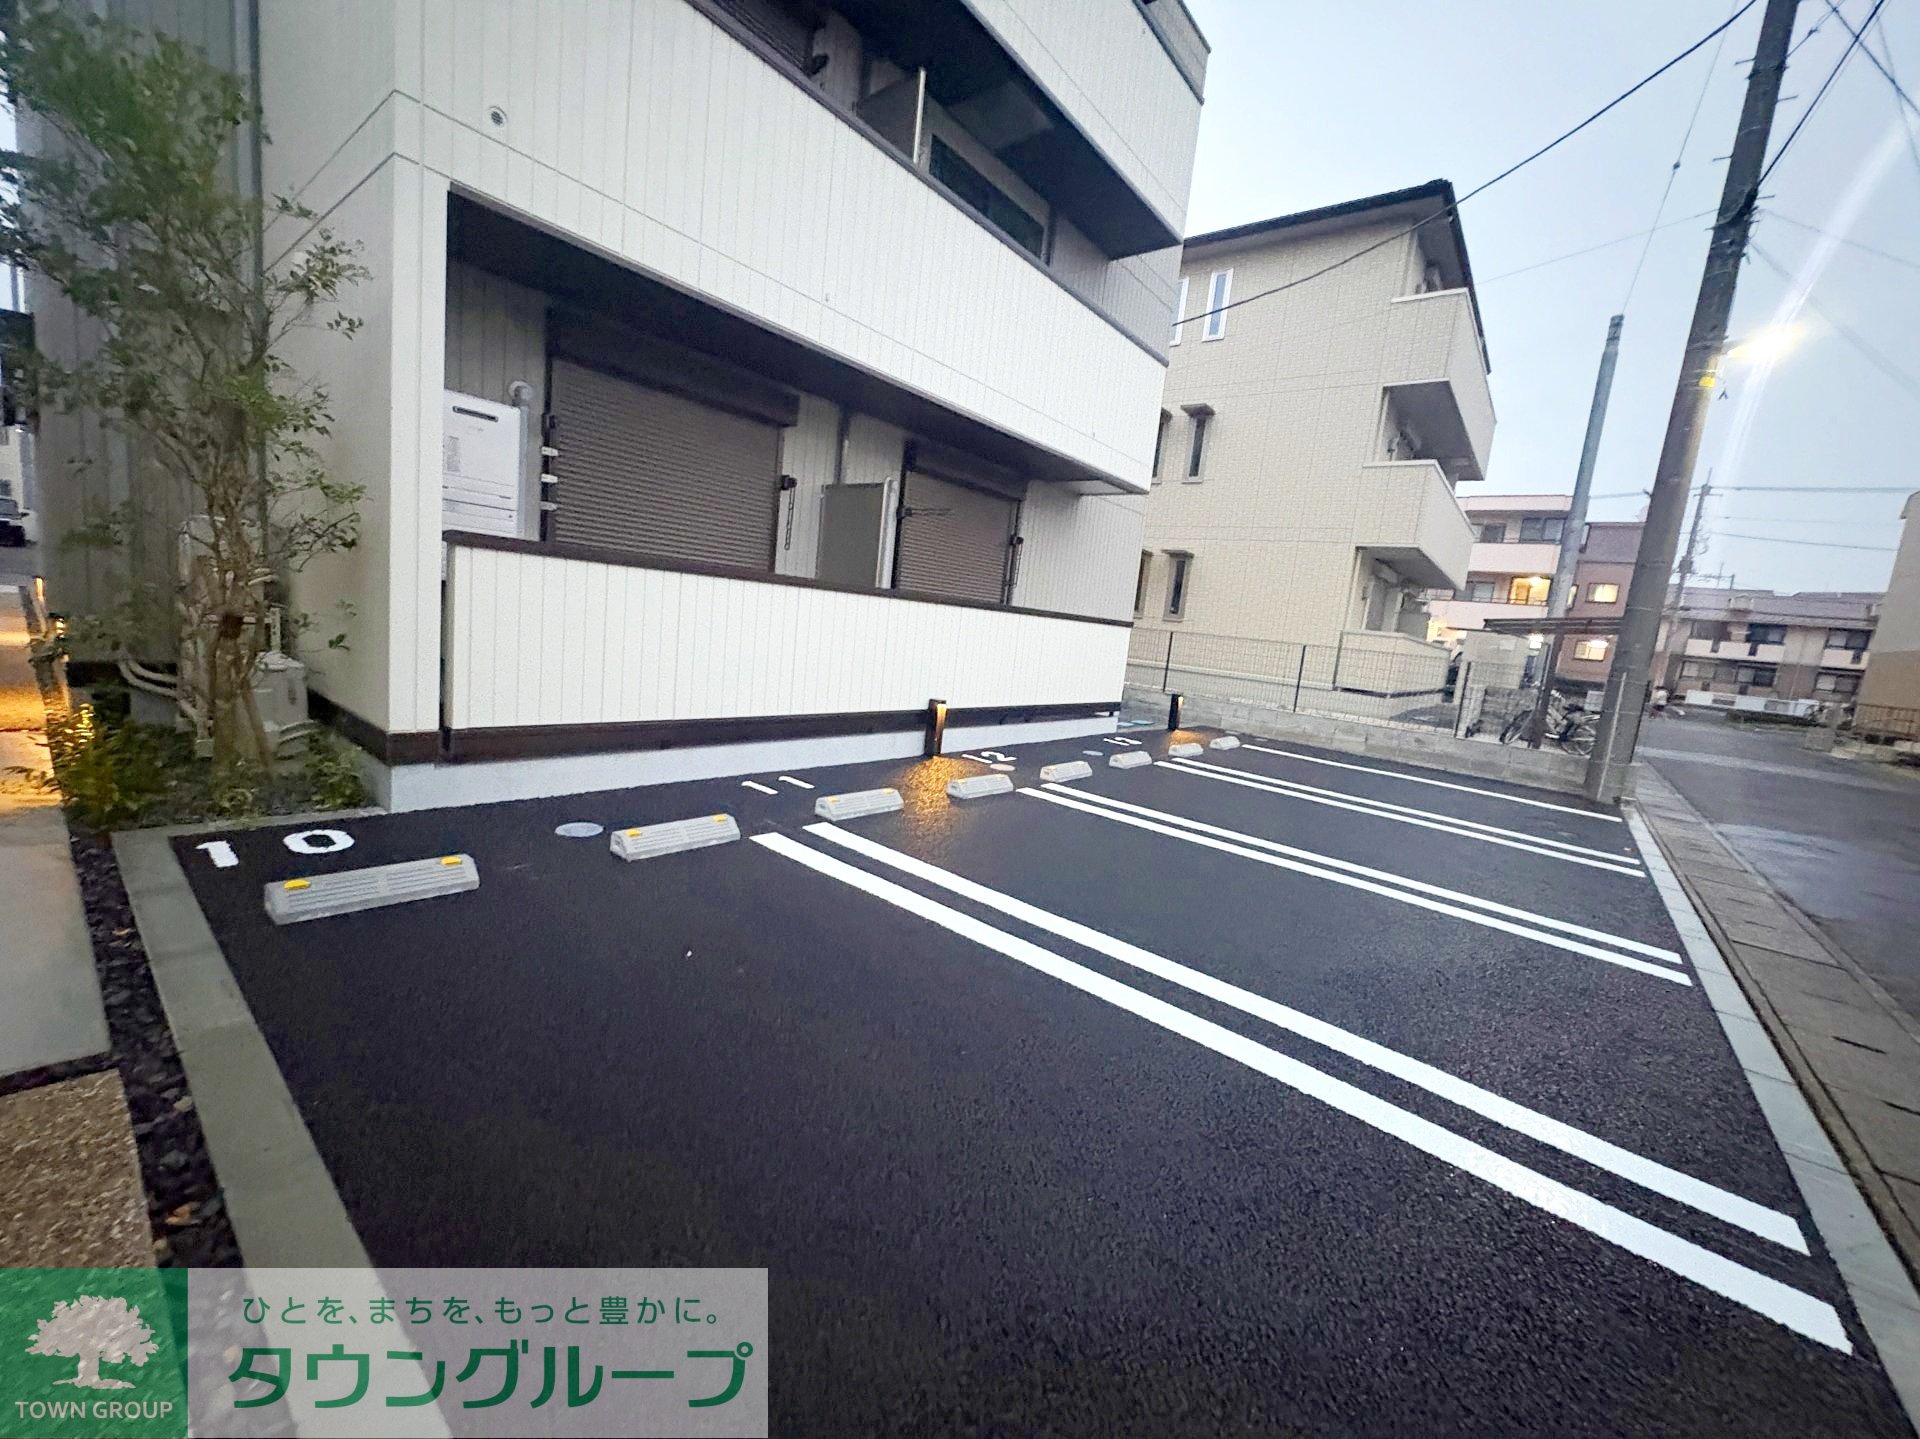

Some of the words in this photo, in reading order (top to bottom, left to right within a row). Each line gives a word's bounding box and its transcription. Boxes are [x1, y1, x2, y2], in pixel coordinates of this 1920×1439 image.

[961, 751, 1017, 764] 12
[741, 775, 815, 795] 11
[195, 829, 355, 868] 10
